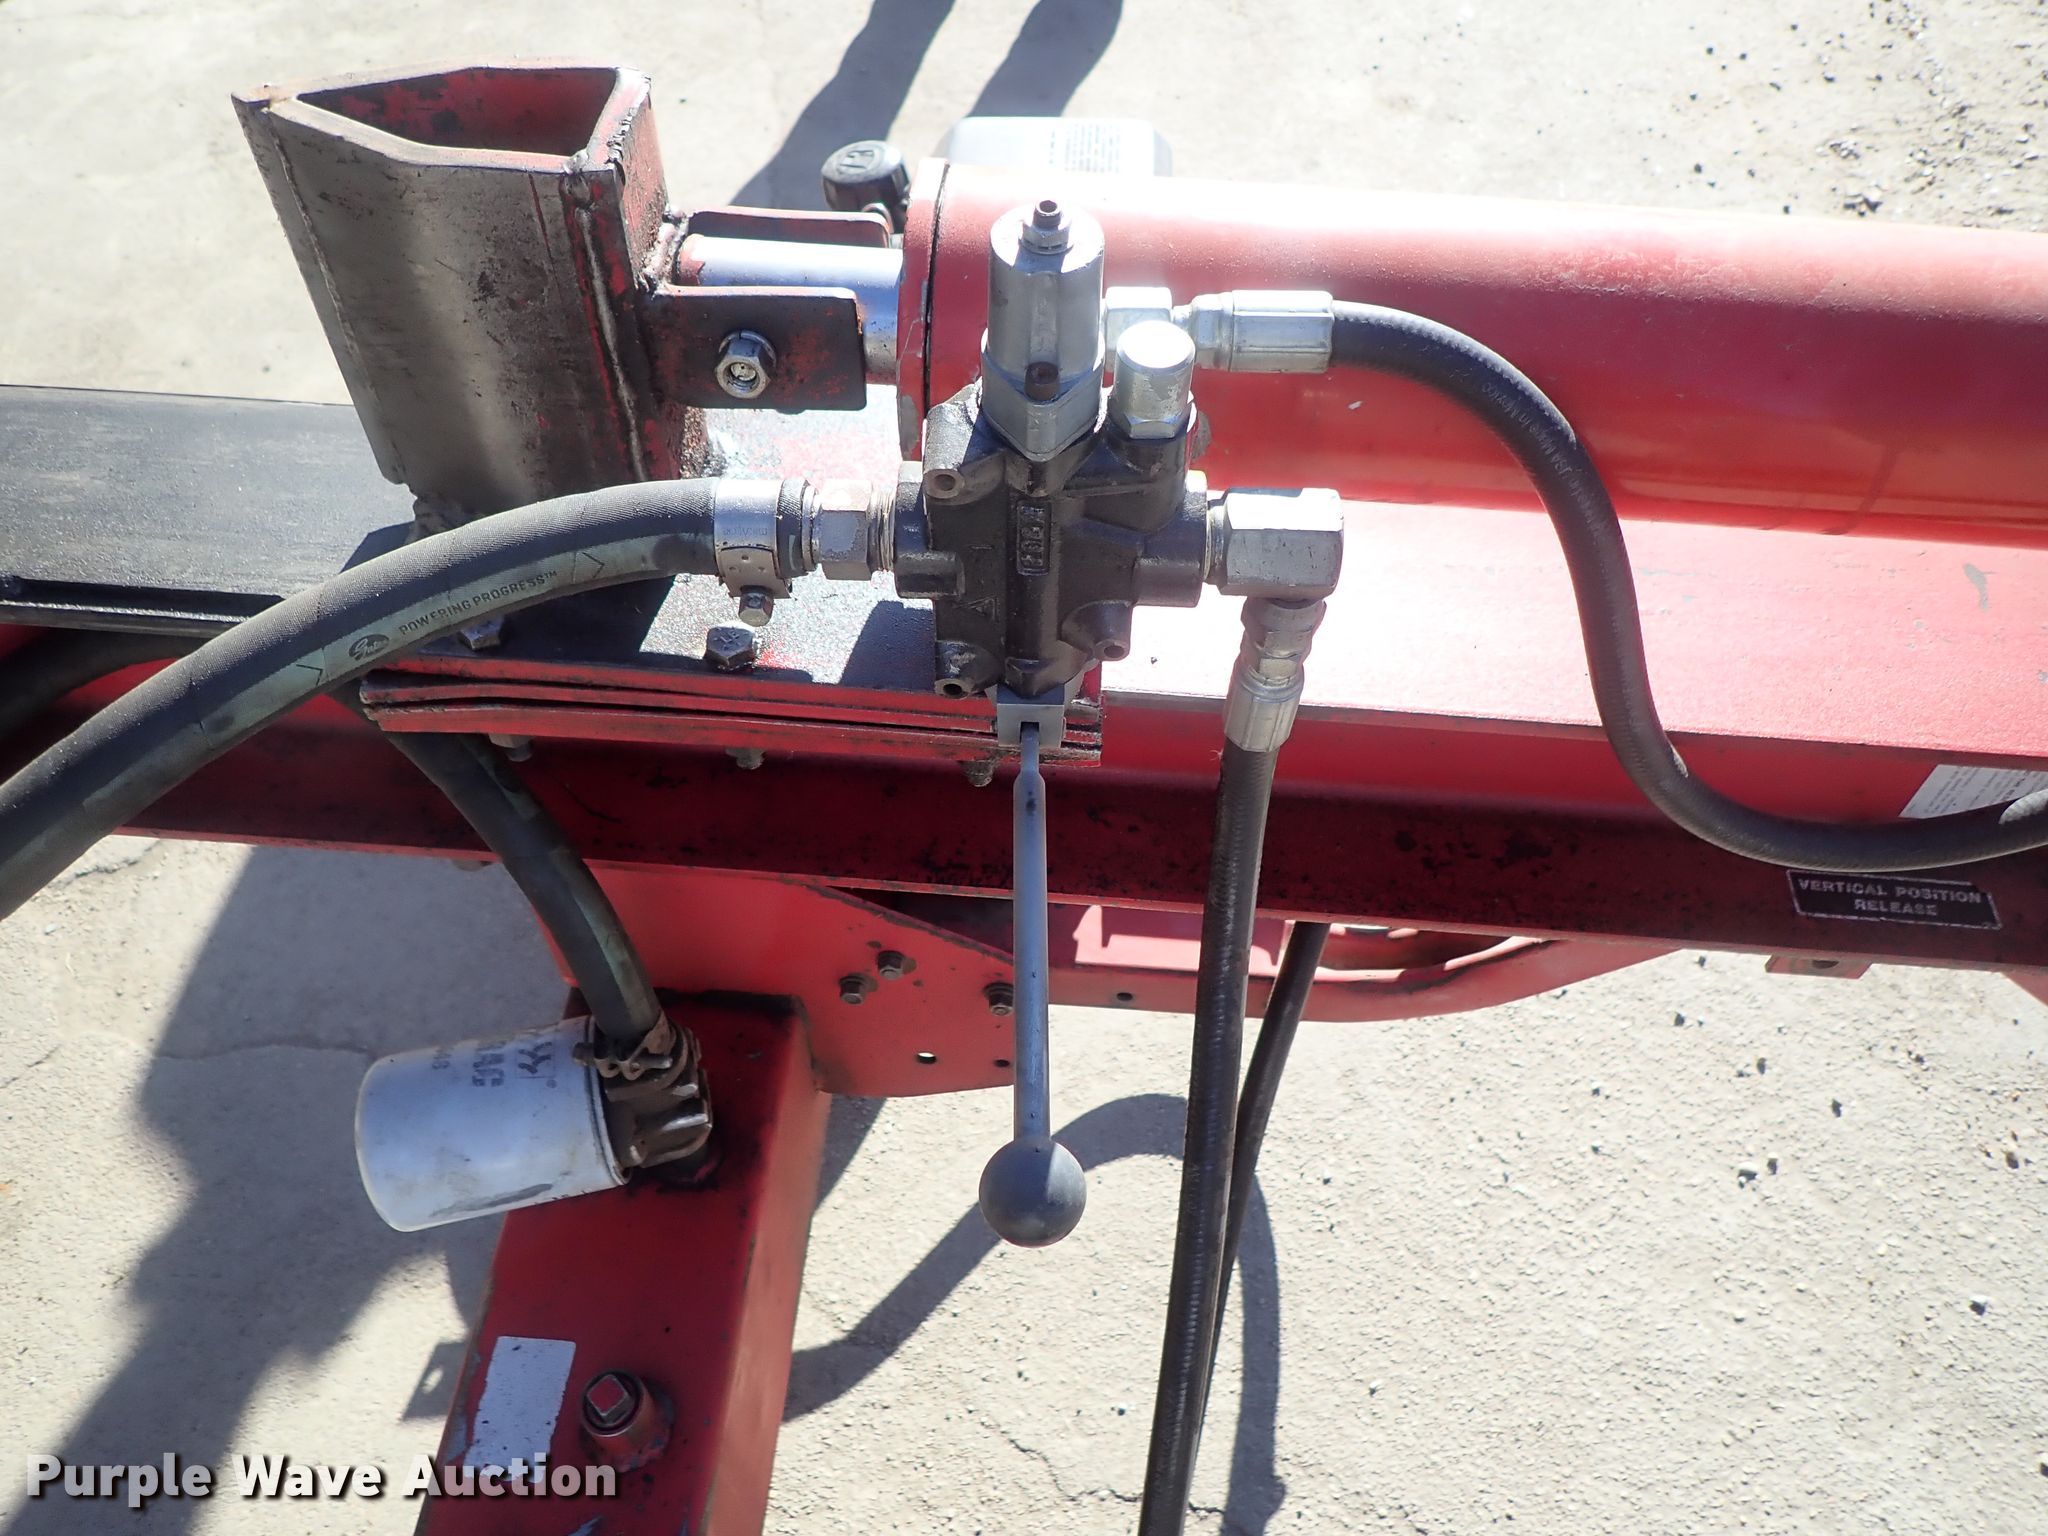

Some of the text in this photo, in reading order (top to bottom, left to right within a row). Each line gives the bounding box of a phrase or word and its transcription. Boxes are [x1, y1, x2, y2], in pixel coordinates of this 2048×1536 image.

[397, 599, 472, 636] POWERING
[1798, 878, 1983, 904] VERTICAL POSITION
[1853, 898, 1939, 916] RELEASE
